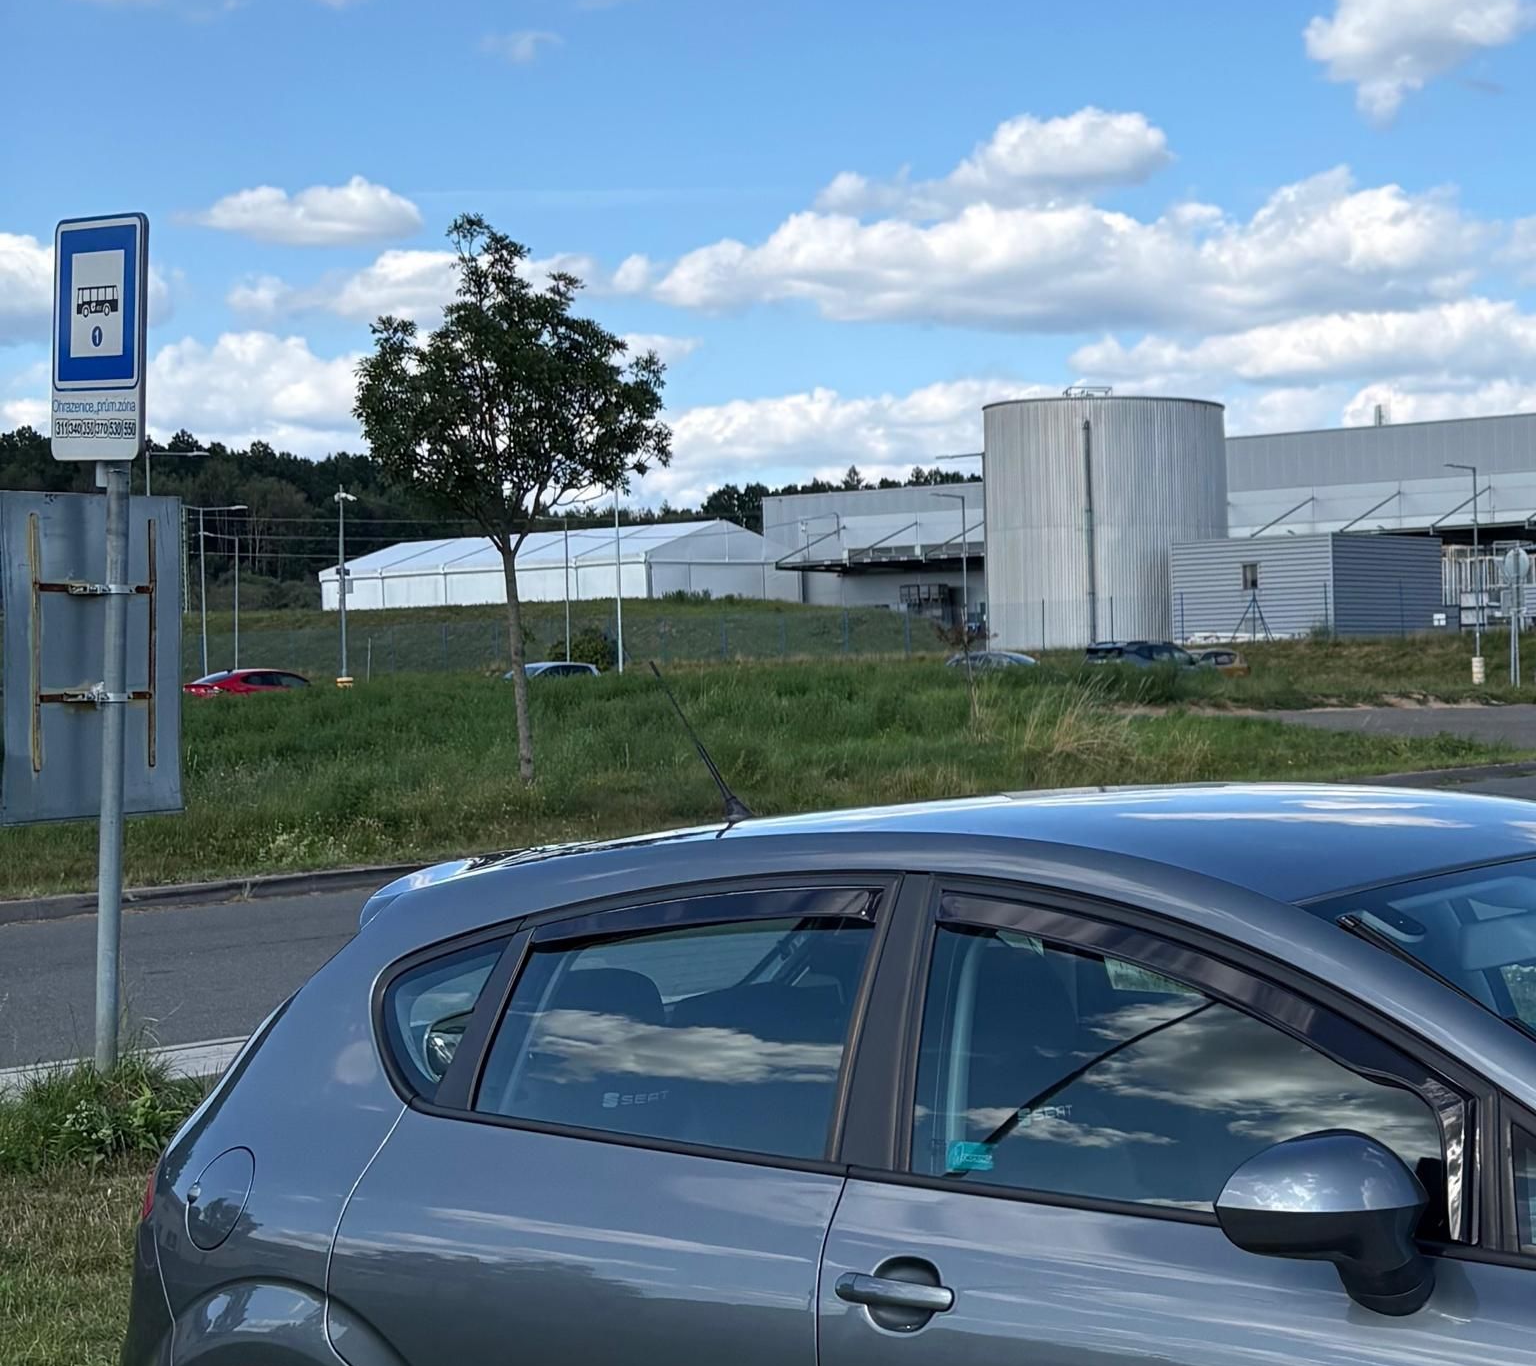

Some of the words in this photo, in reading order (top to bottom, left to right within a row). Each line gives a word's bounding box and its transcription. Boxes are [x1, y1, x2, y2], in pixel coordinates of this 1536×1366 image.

[56, 421, 68, 435] 311
[68, 421, 81, 435] 340
[95, 421, 108, 435] 370
[123, 421, 136, 436] 550
[619, 1090, 670, 1106] SEAT
[1031, 1104, 1073, 1121] SEAT
